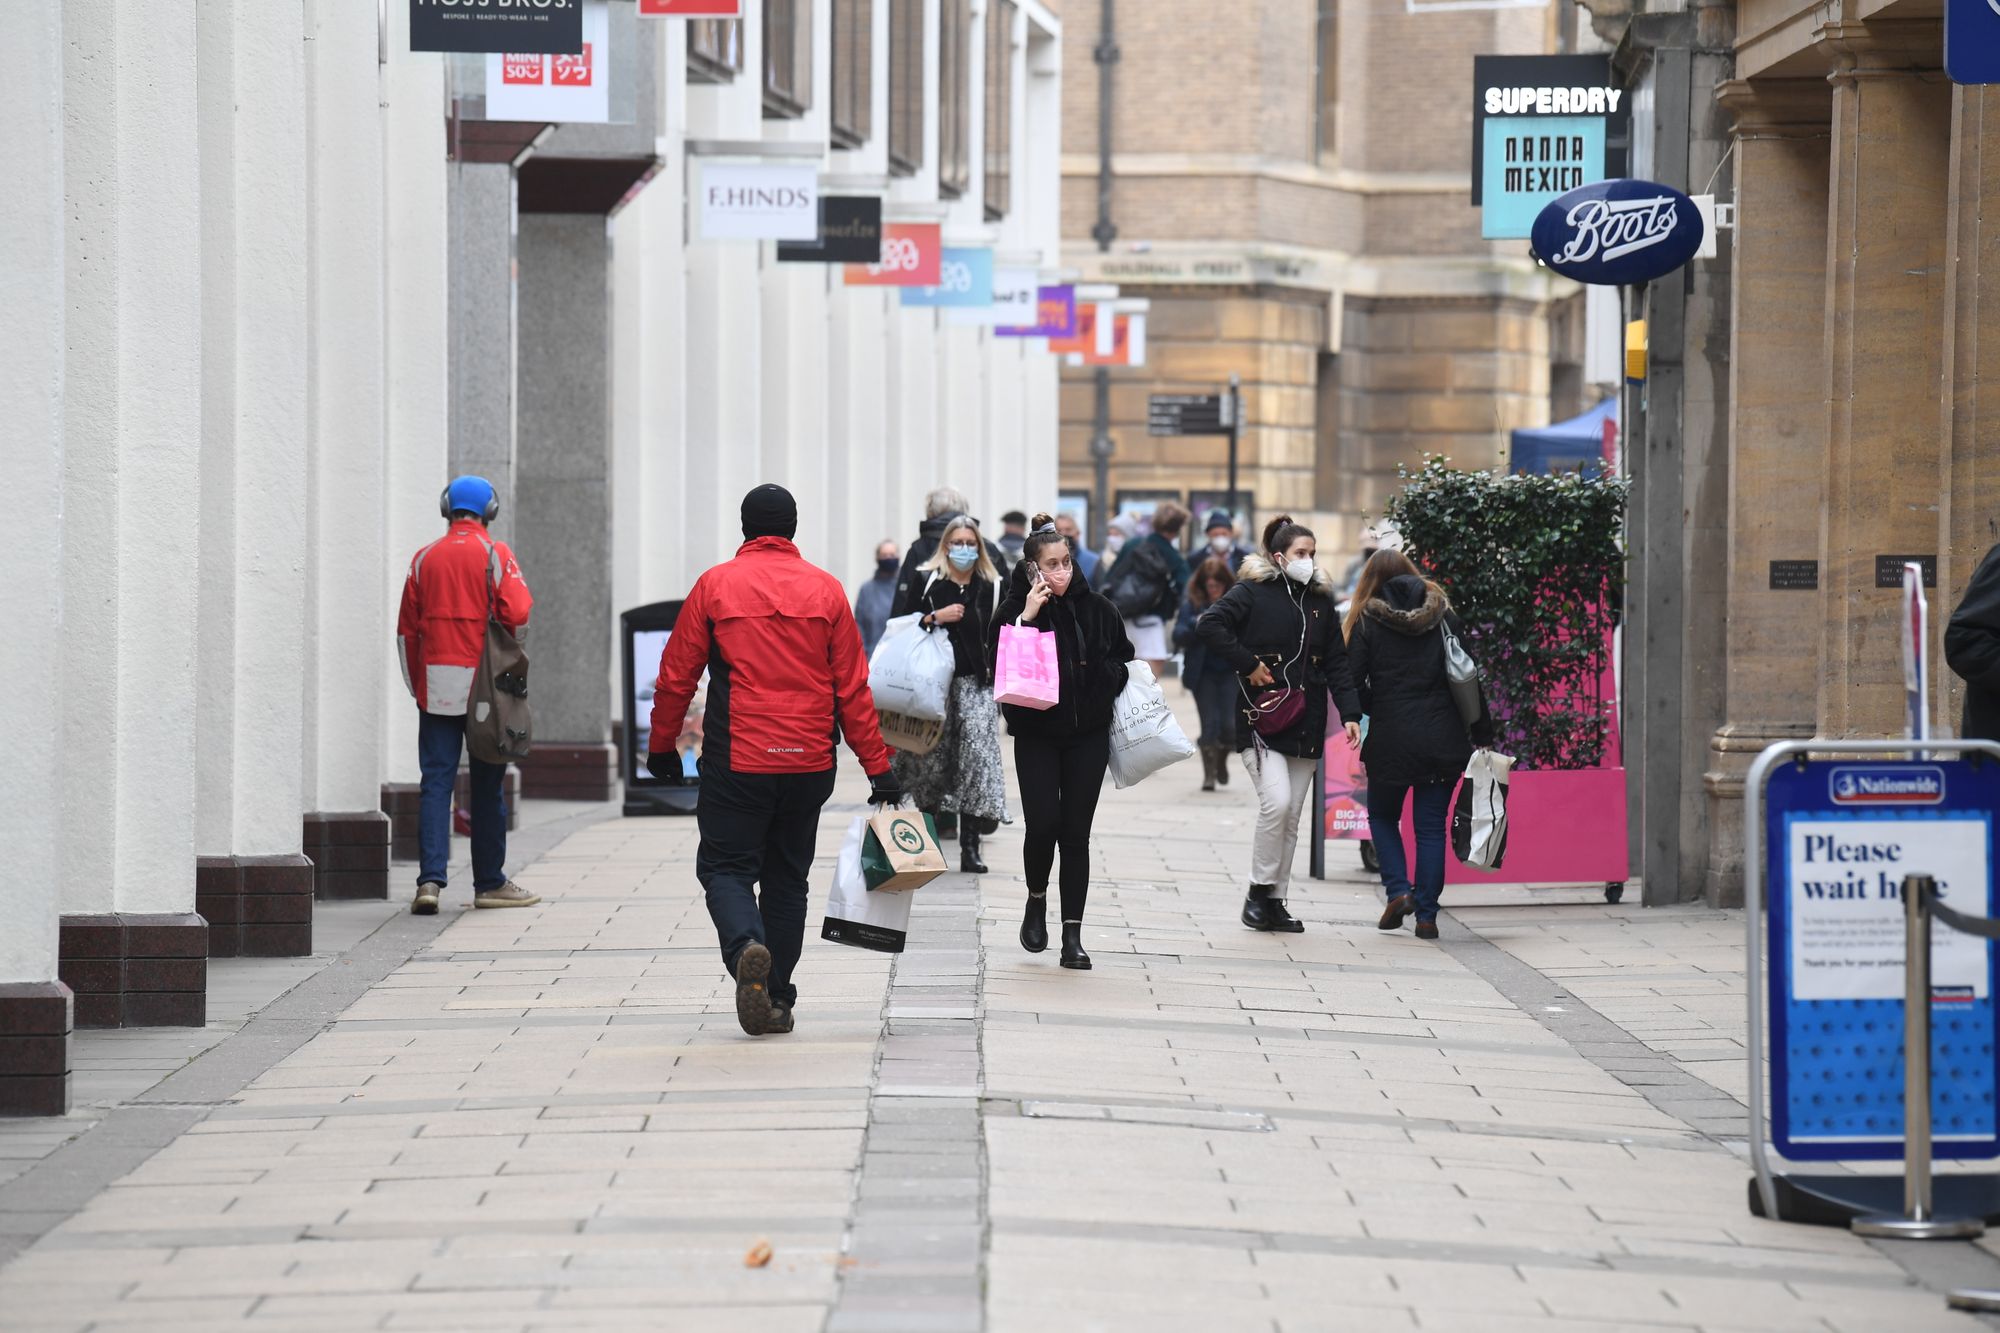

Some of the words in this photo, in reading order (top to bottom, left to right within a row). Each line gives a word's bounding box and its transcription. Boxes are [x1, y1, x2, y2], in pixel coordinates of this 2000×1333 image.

[1485, 87, 1622, 114] SUPERDRY
[1505, 136, 1584, 162] NANNA
[1505, 167, 1583, 192] MEXICO
[709, 186, 810, 208] F.HINDS
[1552, 195, 1678, 263] Boots
[1123, 698, 1161, 720] LOOK
[1859, 776, 1938, 794] Nationwide
[1335, 809, 1369, 820] BIG-A
[1803, 834, 1902, 863] Please
[1803, 871, 1867, 900] wait
[1880, 871, 1949, 900] he
